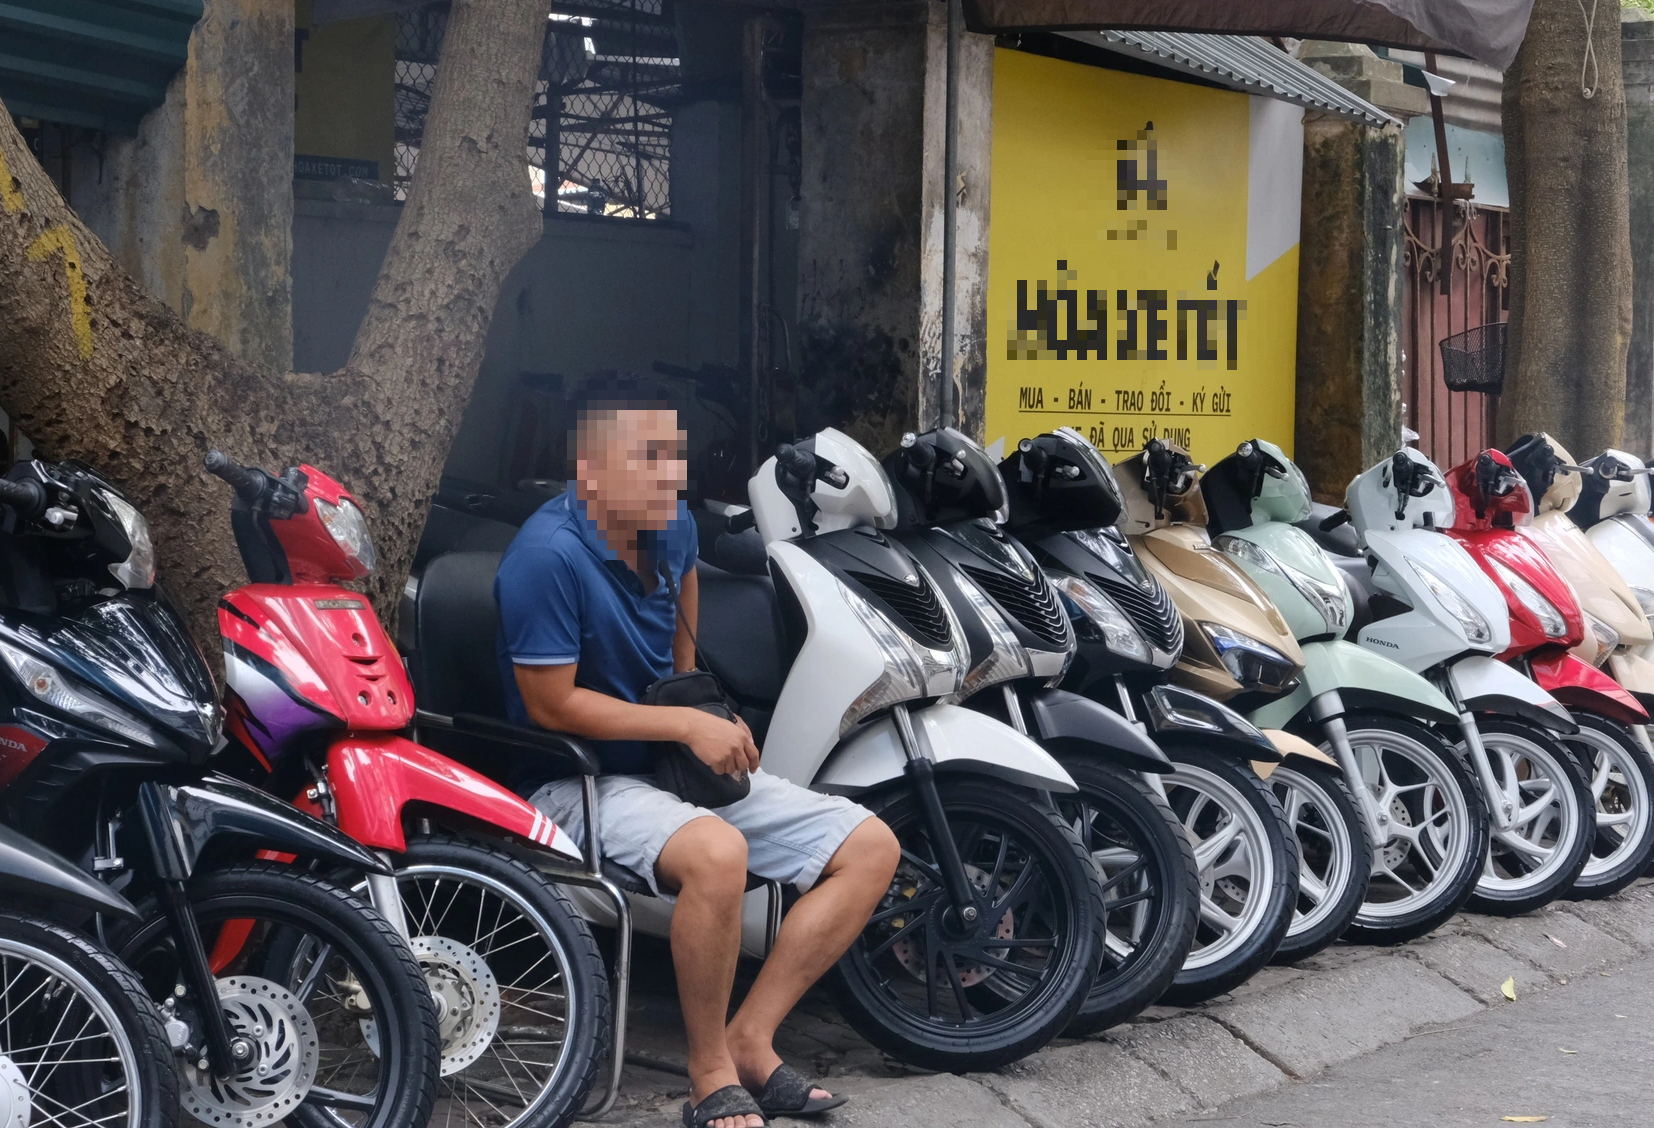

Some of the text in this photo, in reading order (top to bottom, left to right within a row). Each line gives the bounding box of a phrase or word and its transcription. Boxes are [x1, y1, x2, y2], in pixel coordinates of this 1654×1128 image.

[1019, 387, 1044, 409] MUA
[1068, 381, 1092, 410] BÁN
[1115, 390, 1144, 411] TRAO
[1150, 380, 1171, 412] ĐỔI
[1192, 385, 1206, 412] KÝ
[1212, 386, 1231, 413] GỬI
[1090, 421, 1105, 448] ĐÃ
[1112, 427, 1134, 453] QUA
[1366, 636, 1399, 649] HONDA
[0, 737, 27, 752] NDA
